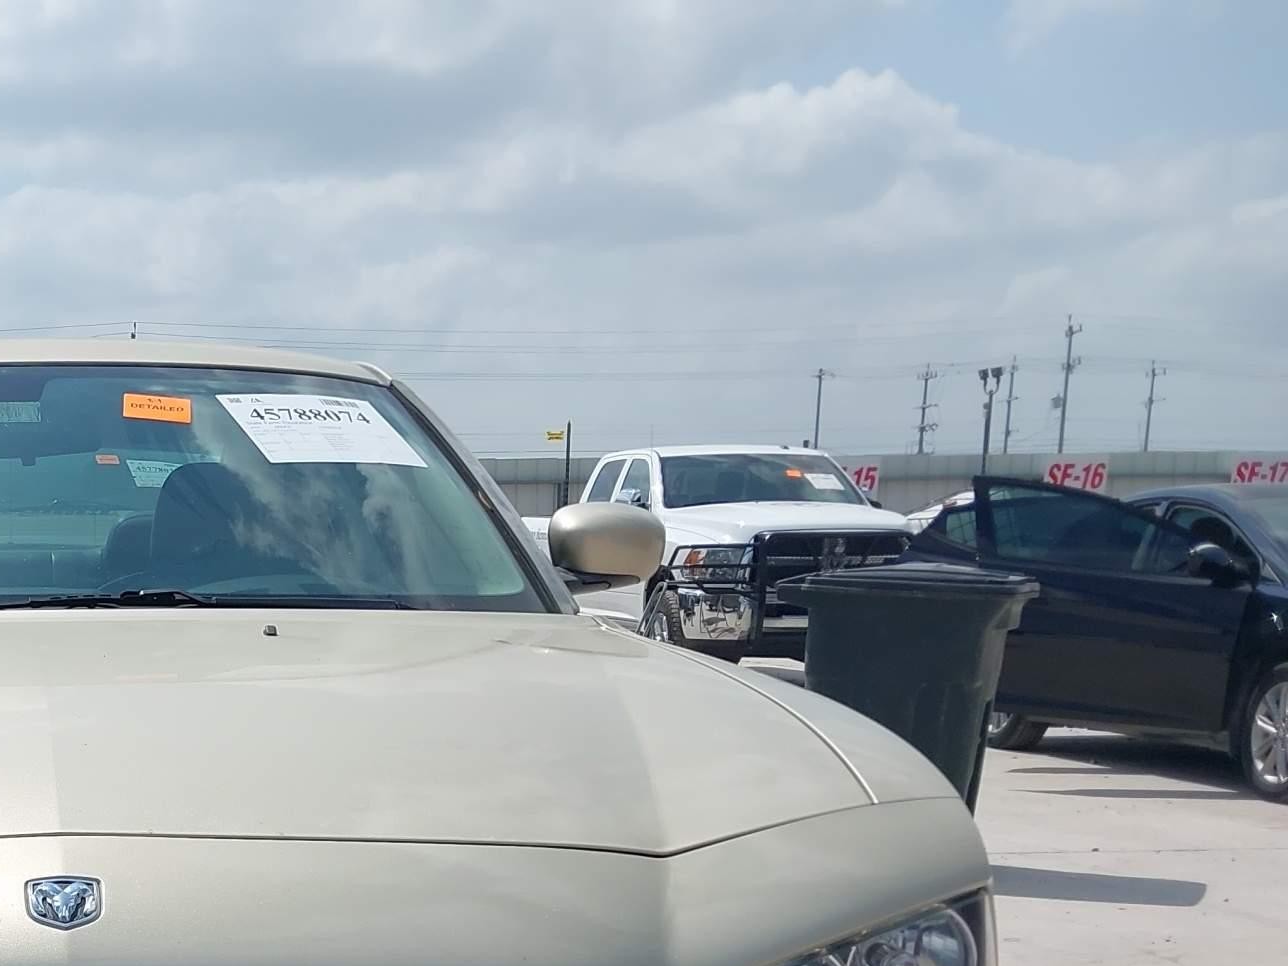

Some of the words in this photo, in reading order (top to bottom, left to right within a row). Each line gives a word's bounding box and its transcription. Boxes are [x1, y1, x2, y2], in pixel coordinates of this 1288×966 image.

[130, 403, 184, 412] DETAILED
[249, 407, 371, 424] 45788074
[1048, 463, 1106, 489] SF-16
[1234, 461, 1288, 483] SF-17
